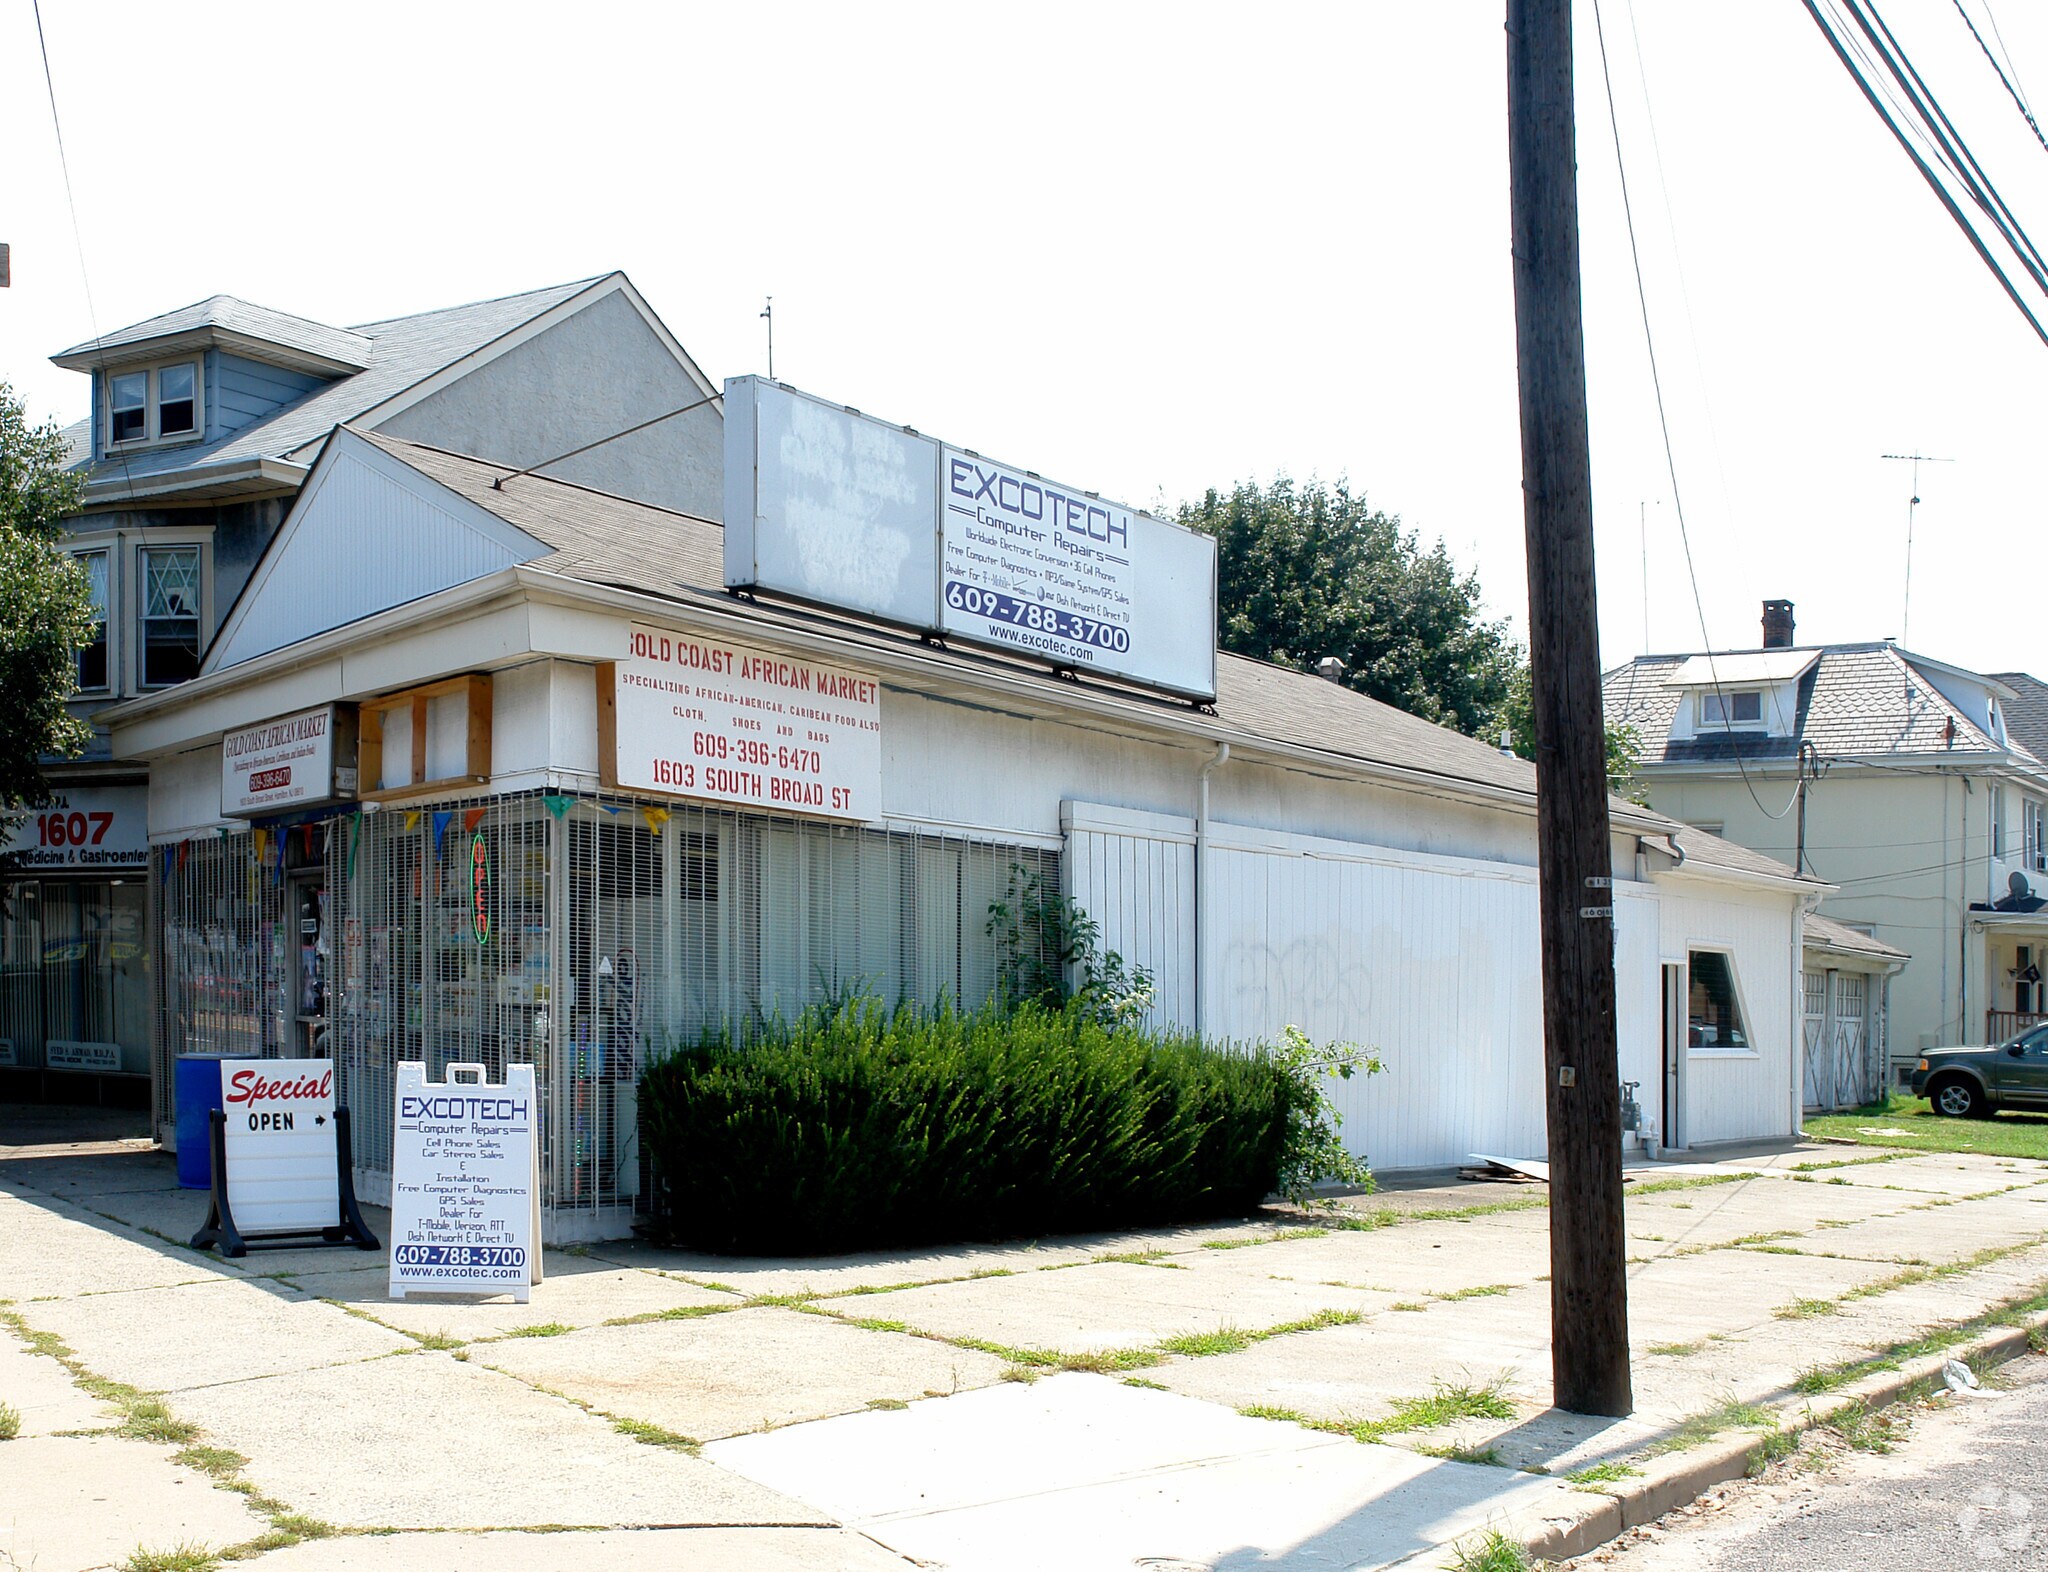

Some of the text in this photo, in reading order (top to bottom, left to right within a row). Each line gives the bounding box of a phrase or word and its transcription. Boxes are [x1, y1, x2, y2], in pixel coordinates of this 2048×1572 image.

[951, 458, 1128, 549] EXCOTECH
[977, 507, 1104, 562] Computer Repairs
[948, 541, 964, 556] Free
[966, 547, 998, 565] Computer
[1001, 557, 1037, 577] Diagnostics
[1114, 591, 1129, 604] Sales
[1000, 537, 1033, 557] Electronic
[1035, 548, 1069, 568] Conversion
[1084, 563, 1093, 576] Cell
[1095, 567, 1116, 583] Phones
[946, 561, 966, 576] Dealer
[969, 568, 980, 580] For
[1057, 593, 1069, 606] Dish
[1071, 597, 1095, 613] Network
[1103, 607, 1121, 620] Direct
[948, 583, 1128, 652] 609-788-3700
[988, 623, 1094, 662] www.excotec.com
[677, 642, 733, 675] COAST
[741, 656, 810, 691] AFRICAN
[817, 672, 877, 705] MARKET
[622, 674, 690, 695] SPECIALIZING
[789, 705, 831, 723] CARIBEAN
[835, 714, 856, 727] FOOD
[859, 718, 880, 732] ALSO
[225, 713, 328, 759] GOLD COAST AFRICAN MARKET
[732, 717, 762, 731] SHOES
[776, 725, 793, 737] AND
[807, 730, 830, 744] BAGS
[693, 731, 820, 774] 609-396-6470
[250, 768, 290, 791] 609-396-6470
[652, 758, 851, 810] 1603 SOUTH BROAD ST
[37, 812, 114, 847] 1607
[68, 849, 75, 863] &
[226, 1069, 332, 1108] Special
[248, 1112, 294, 1131] OPEN
[402, 1097, 527, 1120] EXCOTECH
[418, 1121, 509, 1136] Computer Repairs
[422, 1148, 504, 1159] Car Stereo Sales
[426, 1138, 500, 1148] Cell Phone Sales
[398, 1183, 526, 1195] Free Computer Diagnostics
[436, 1173, 490, 1183] Installation
[439, 1196, 485, 1206] GPS Sales
[440, 1207, 483, 1218] Dealer For
[408, 1231, 424, 1241] Dish
[428, 1231, 463, 1242] Network
[475, 1232, 500, 1243] Direct
[397, 1246, 524, 1265] 609-788-3700
[400, 1267, 521, 1278] www.excotec.com
